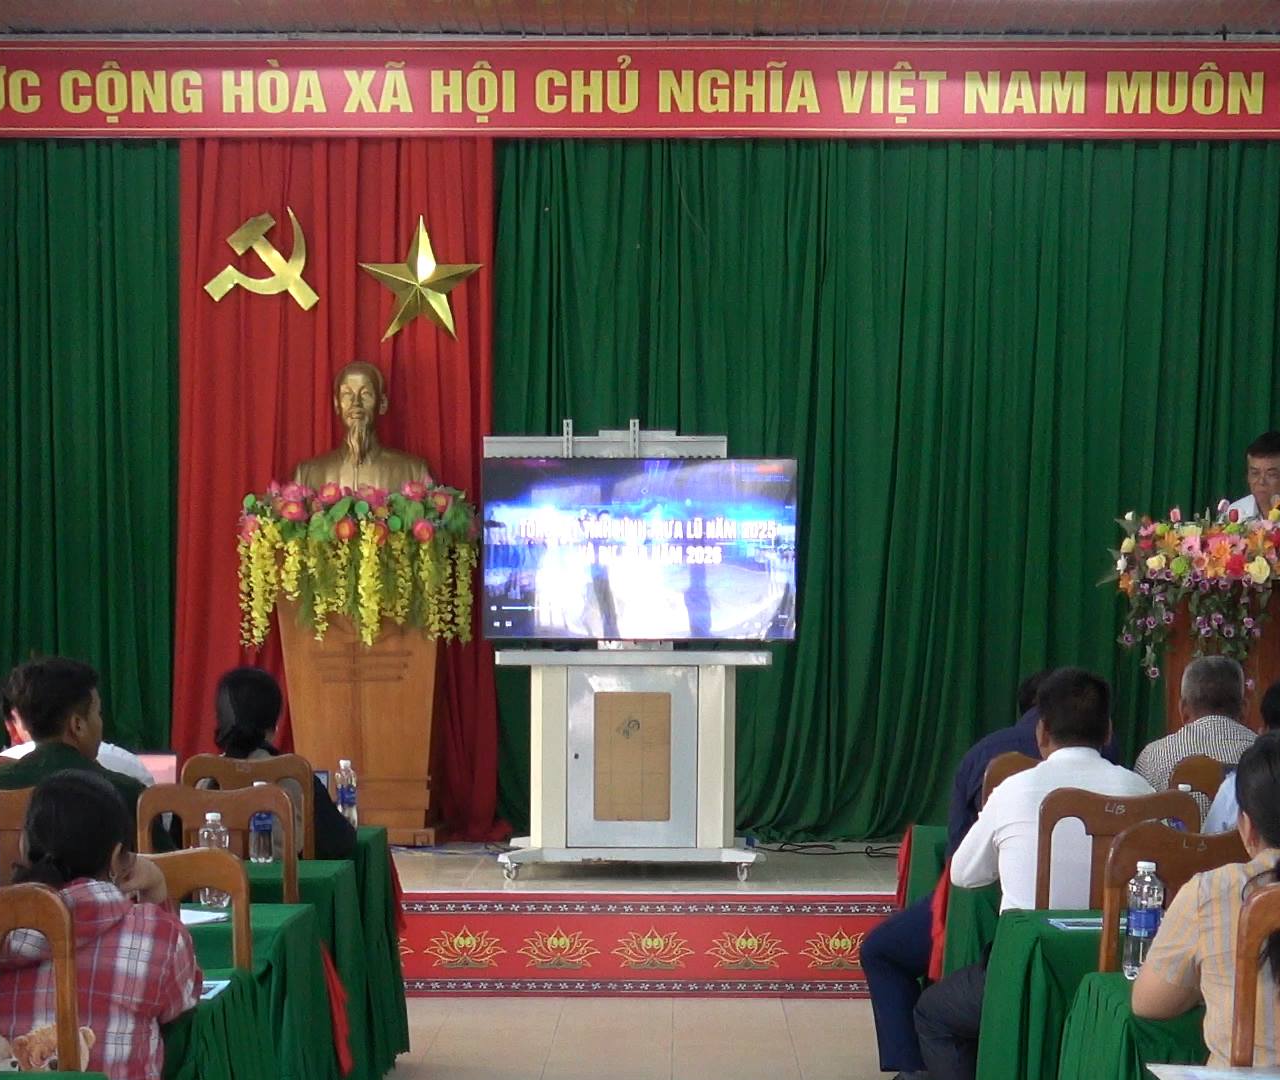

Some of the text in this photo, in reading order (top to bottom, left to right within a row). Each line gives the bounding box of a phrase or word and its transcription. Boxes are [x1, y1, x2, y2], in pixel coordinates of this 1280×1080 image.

[60, 61, 203, 123] CỘNG
[222, 59, 327, 113] HÒA
[343, 60, 413, 113] XÃ
[430, 60, 515, 123] HỘI
[535, 55, 639, 113] CHỦ
[658, 61, 820, 113] NGHĨA
[836, 61, 947, 123] VIỆT
[964, 71, 1086, 113] NAM
[1105, 62, 1264, 115] MUÔN
